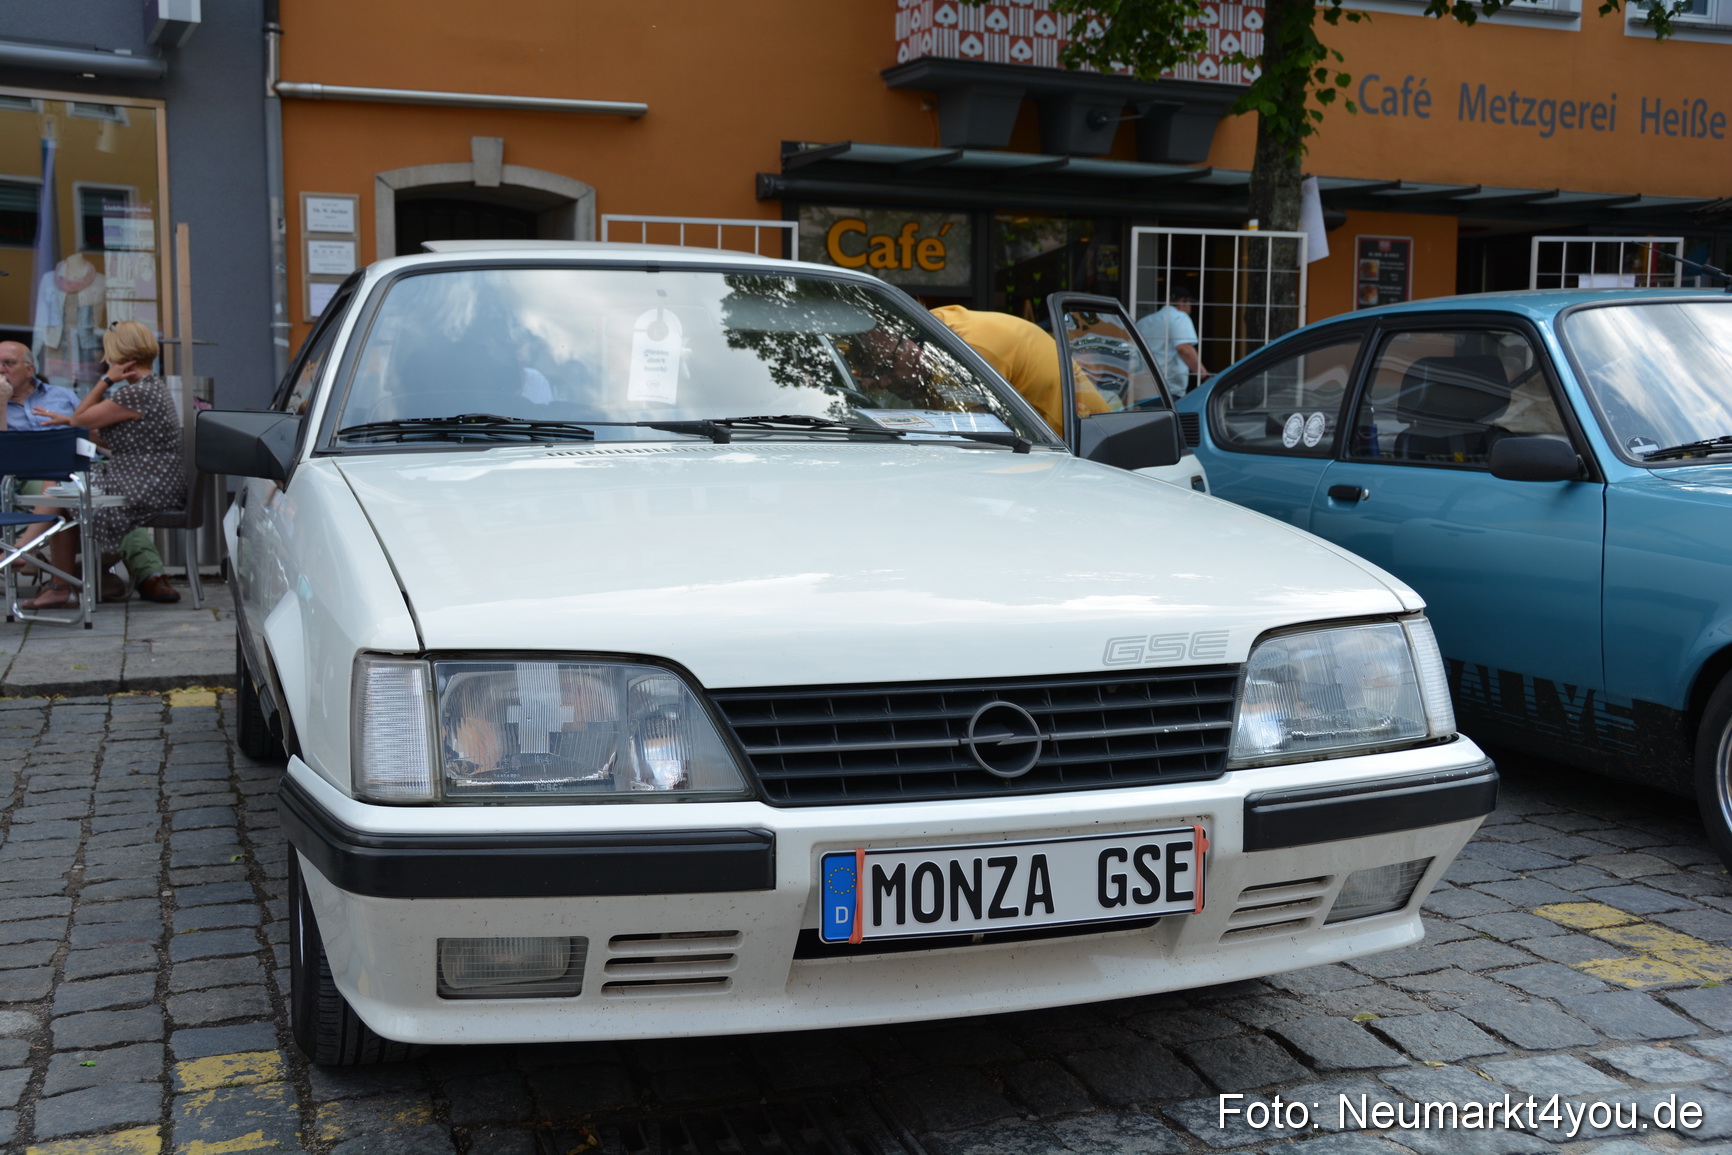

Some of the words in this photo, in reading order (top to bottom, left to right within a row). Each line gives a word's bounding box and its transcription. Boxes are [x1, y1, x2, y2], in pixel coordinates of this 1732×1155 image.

[1357, 73, 1432, 119] Café
[1458, 82, 1618, 139] Metzgerei
[1639, 96, 1727, 140] Heiße
[826, 217, 953, 272] Café
[1102, 629, 1230, 667] GSE
[871, 853, 1056, 927] MONZA
[1097, 840, 1194, 909] GSE
[835, 906, 849, 925] D
